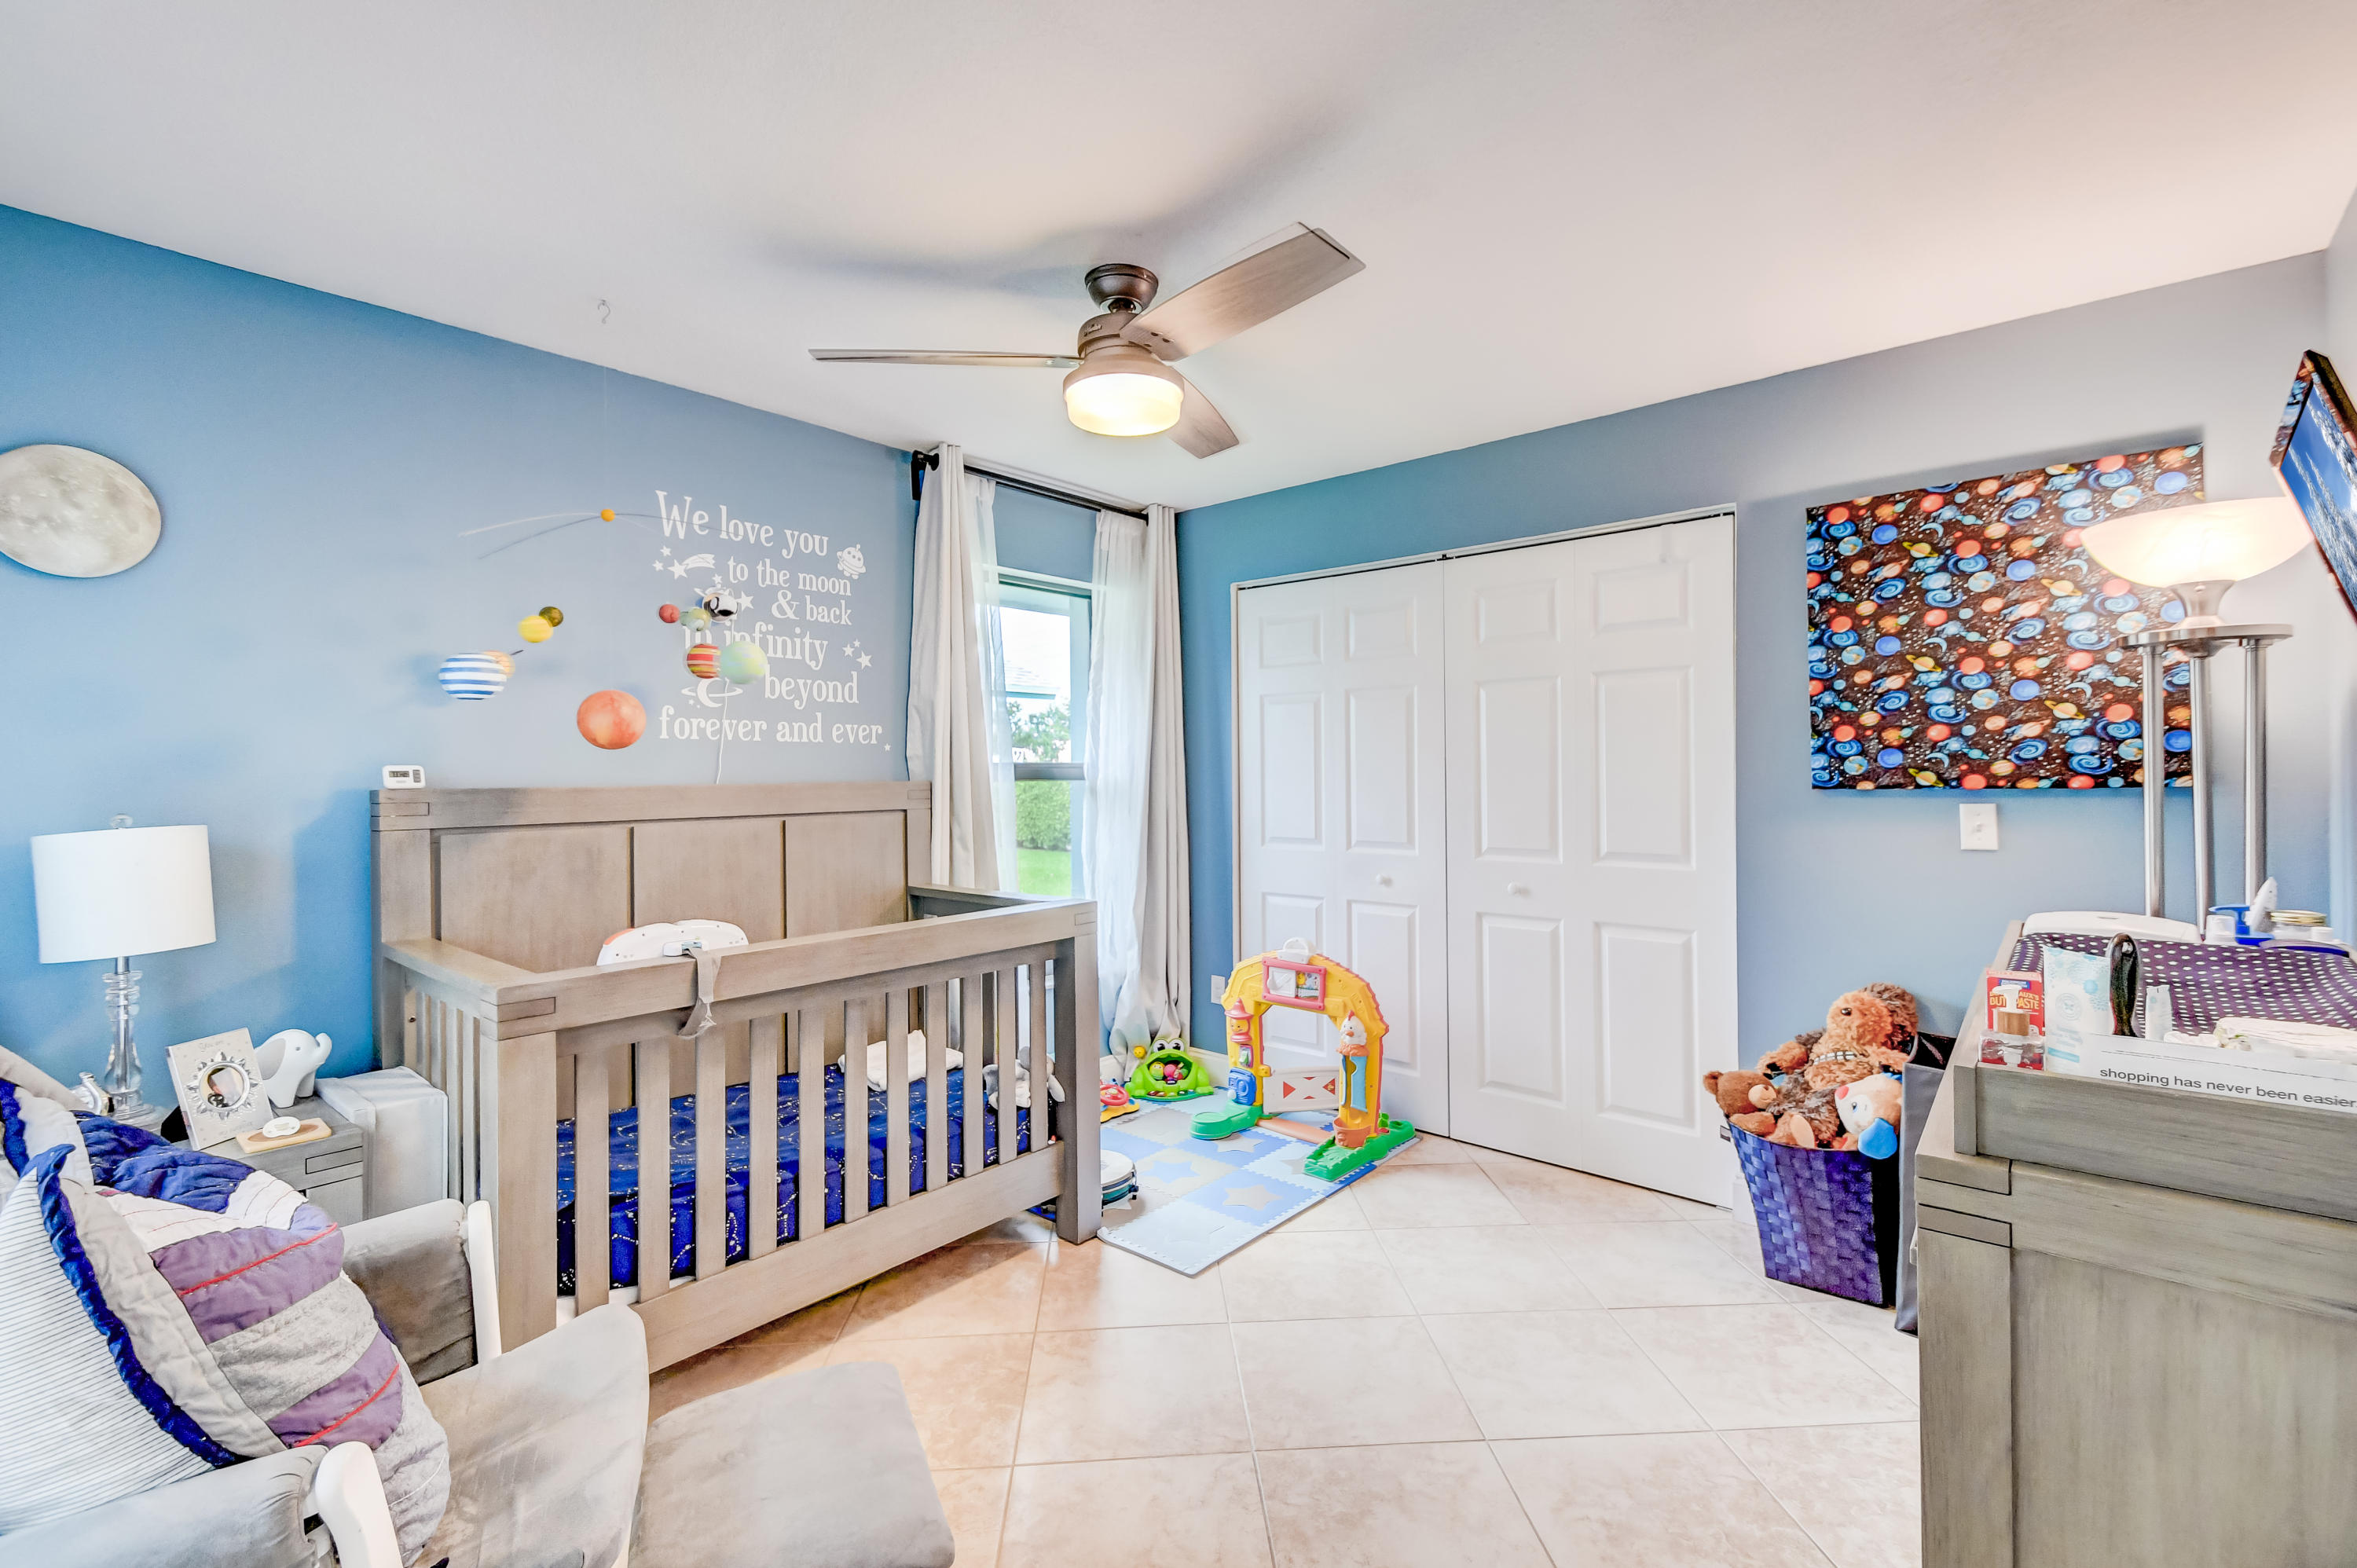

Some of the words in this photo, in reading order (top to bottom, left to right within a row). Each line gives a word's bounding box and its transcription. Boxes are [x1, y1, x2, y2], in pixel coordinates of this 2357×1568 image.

[655, 490, 709, 540] We
[719, 505, 774, 547] love
[782, 529, 829, 559] you
[728, 555, 749, 584] to
[757, 559, 790, 588] the
[797, 571, 852, 596] moon
[772, 589, 800, 620] &
[805, 595, 852, 625] back
[764, 664, 859, 709] beyond
[659, 705, 768, 741] forever
[776, 712, 824, 743] and
[831, 723, 882, 745] ever
[2017, 997, 2040, 1009] ASTE
[2099, 1068, 2169, 1087] shopping
[2174, 1075, 2201, 1089] has
[2206, 1082, 2252, 1094] never
[2256, 1086, 2297, 1101] been
